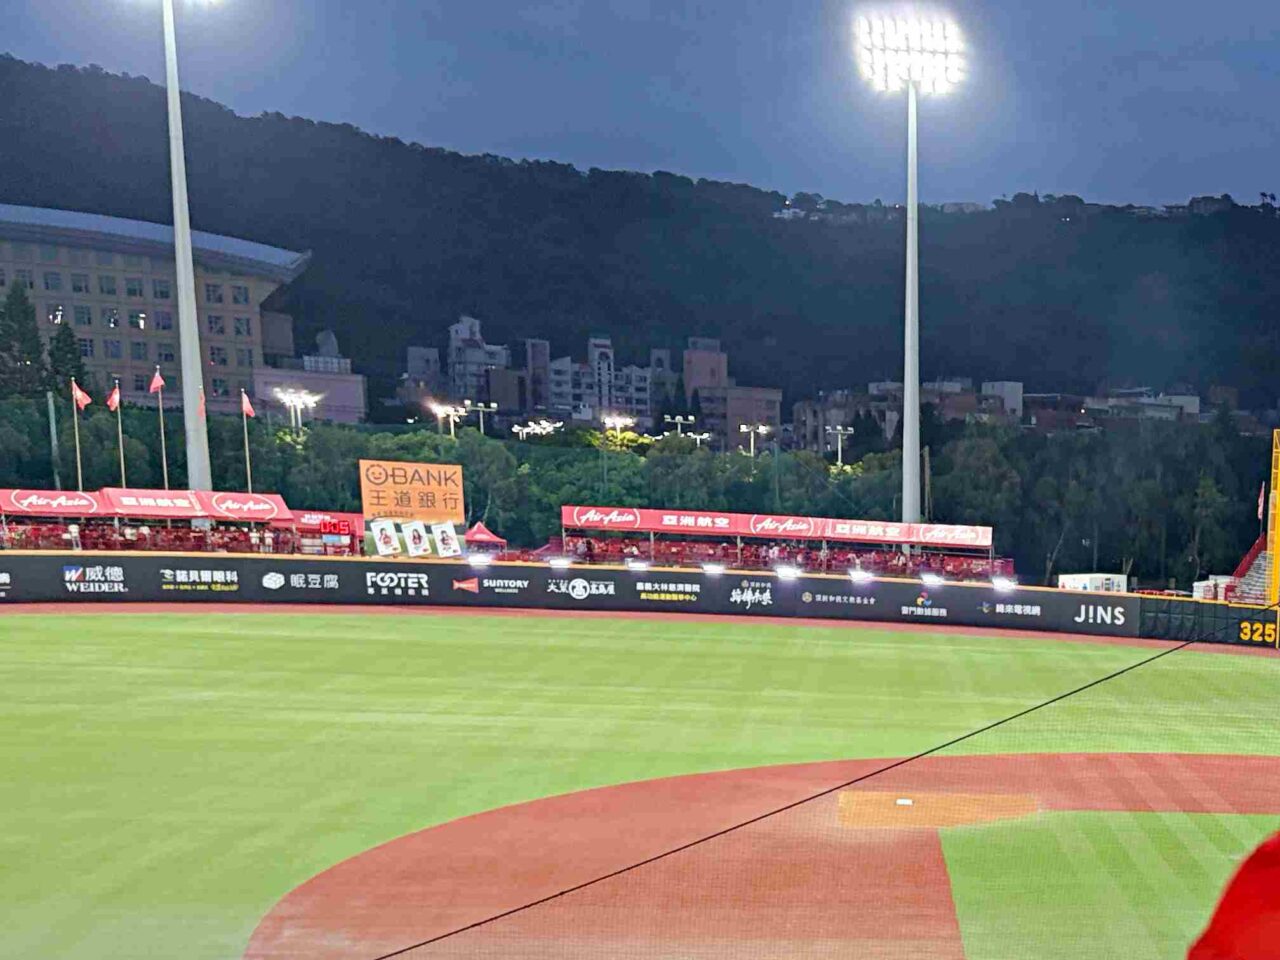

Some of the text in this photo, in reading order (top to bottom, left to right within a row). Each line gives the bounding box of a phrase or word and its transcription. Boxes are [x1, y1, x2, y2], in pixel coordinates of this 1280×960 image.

[369, 489, 459, 510] 王道銀行
[579, 509, 635, 523] AirAsia
[662, 514, 730, 528] 亞洲航空
[755, 516, 808, 532] AirAsia
[835, 523, 901, 538] 亞洲航空
[85, 566, 125, 582] 威德
[290, 573, 339, 589] 眠豆腐
[366, 572, 429, 588] FOOTER
[66, 582, 125, 593] WEIDER
[1240, 621, 1276, 643] 325
